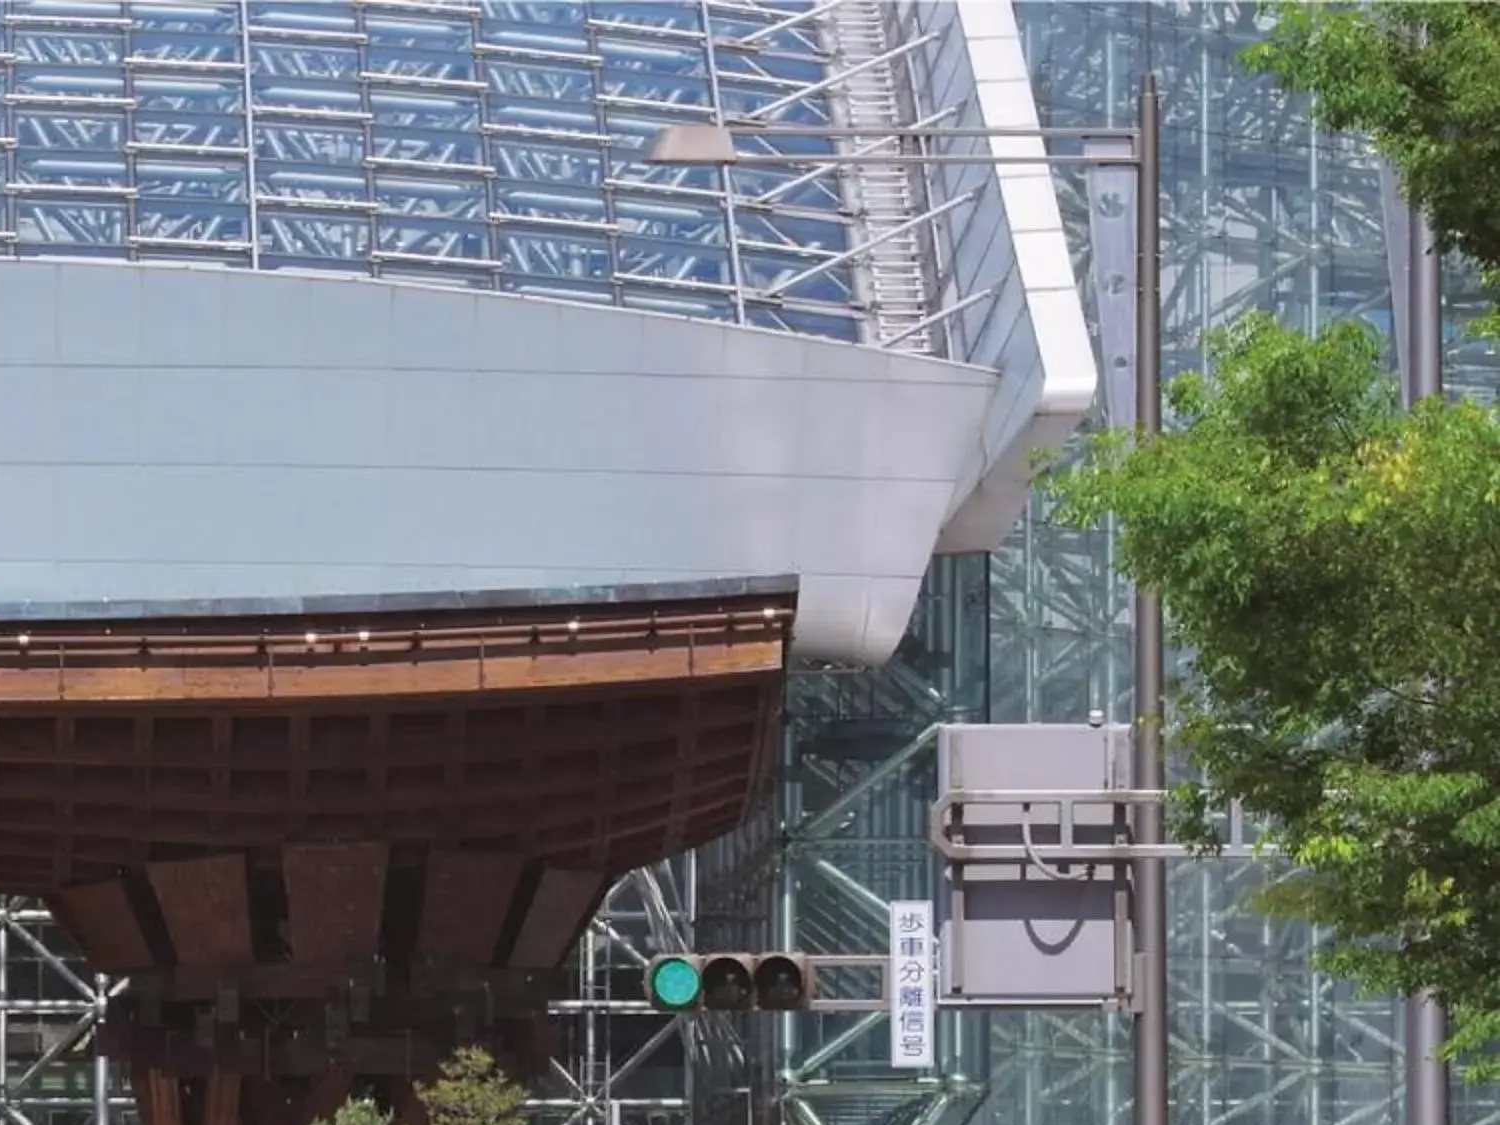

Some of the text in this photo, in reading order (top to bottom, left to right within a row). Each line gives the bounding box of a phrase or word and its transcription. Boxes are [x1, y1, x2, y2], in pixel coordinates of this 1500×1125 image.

[899, 911, 926, 1057] 歩車分離信号
